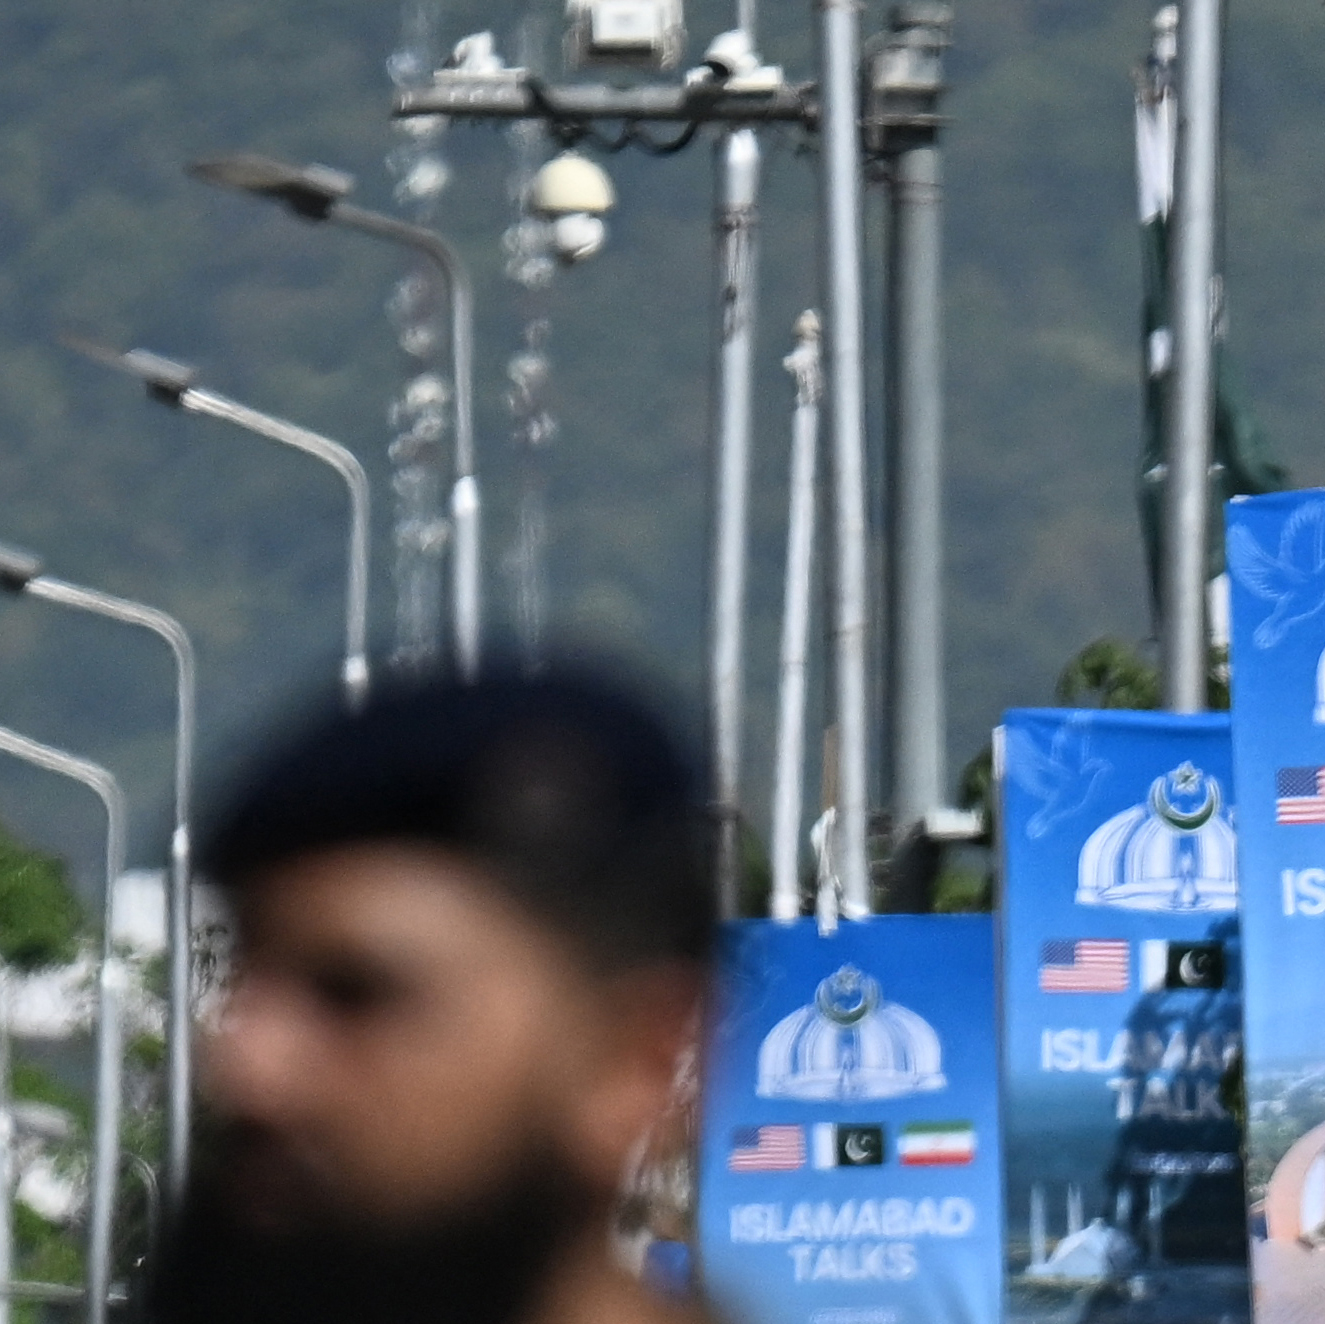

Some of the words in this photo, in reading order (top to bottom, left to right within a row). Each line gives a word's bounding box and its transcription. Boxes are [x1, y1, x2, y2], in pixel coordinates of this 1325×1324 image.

[1106, 1076, 1230, 1121] TALK
[729, 1196, 975, 1244] ISLAMABAD
[789, 1242, 919, 1281] TALKS
